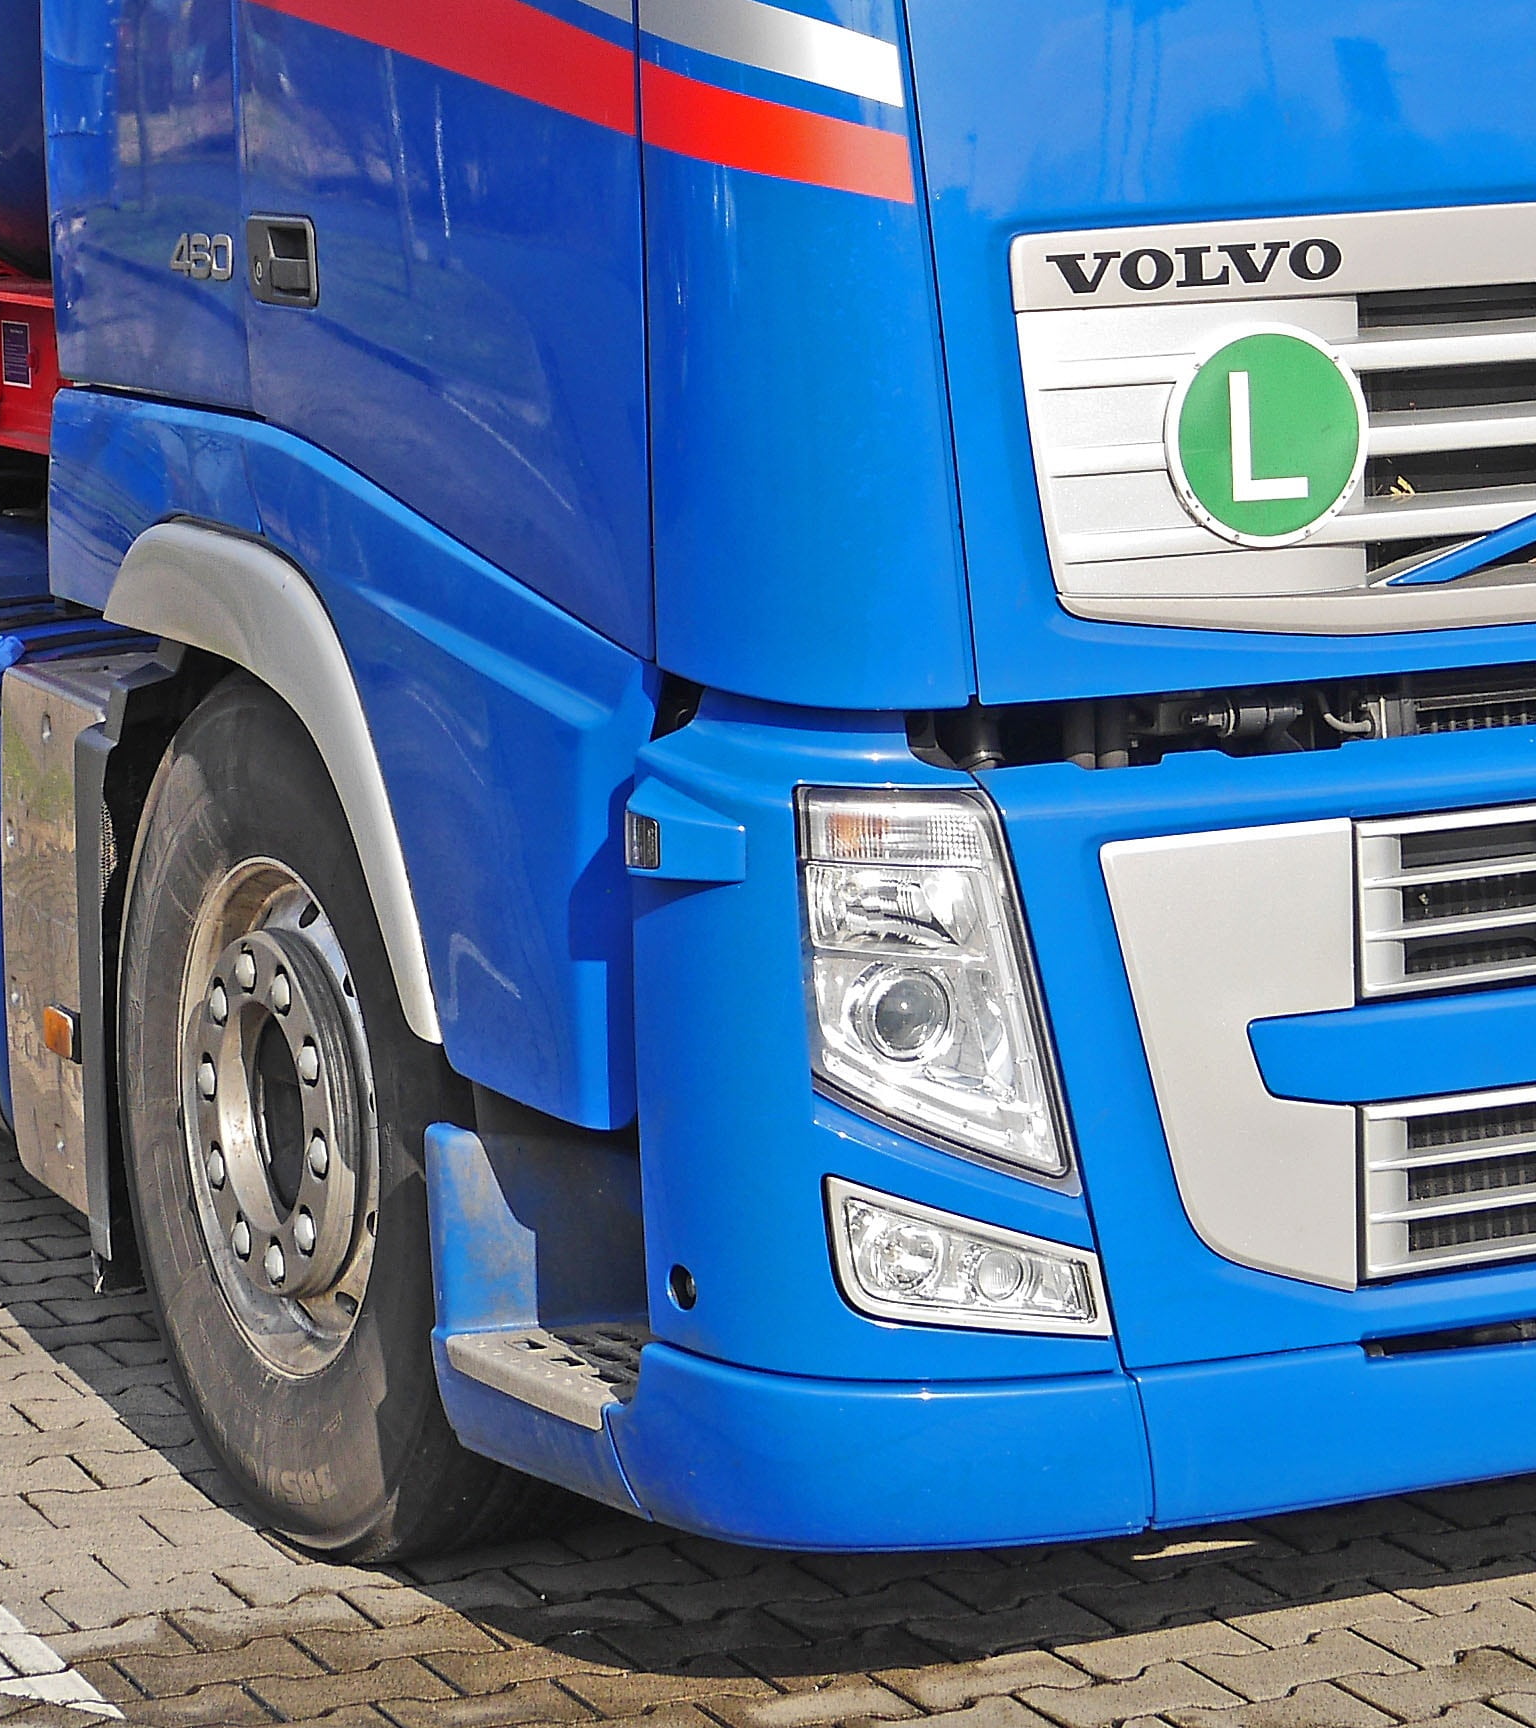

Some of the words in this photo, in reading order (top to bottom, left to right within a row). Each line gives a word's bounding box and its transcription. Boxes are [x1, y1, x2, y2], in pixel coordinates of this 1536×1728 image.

[169, 232, 234, 281] 460
[1045, 238, 1343, 295] VOLVO
[1228, 370, 1310, 503] L
